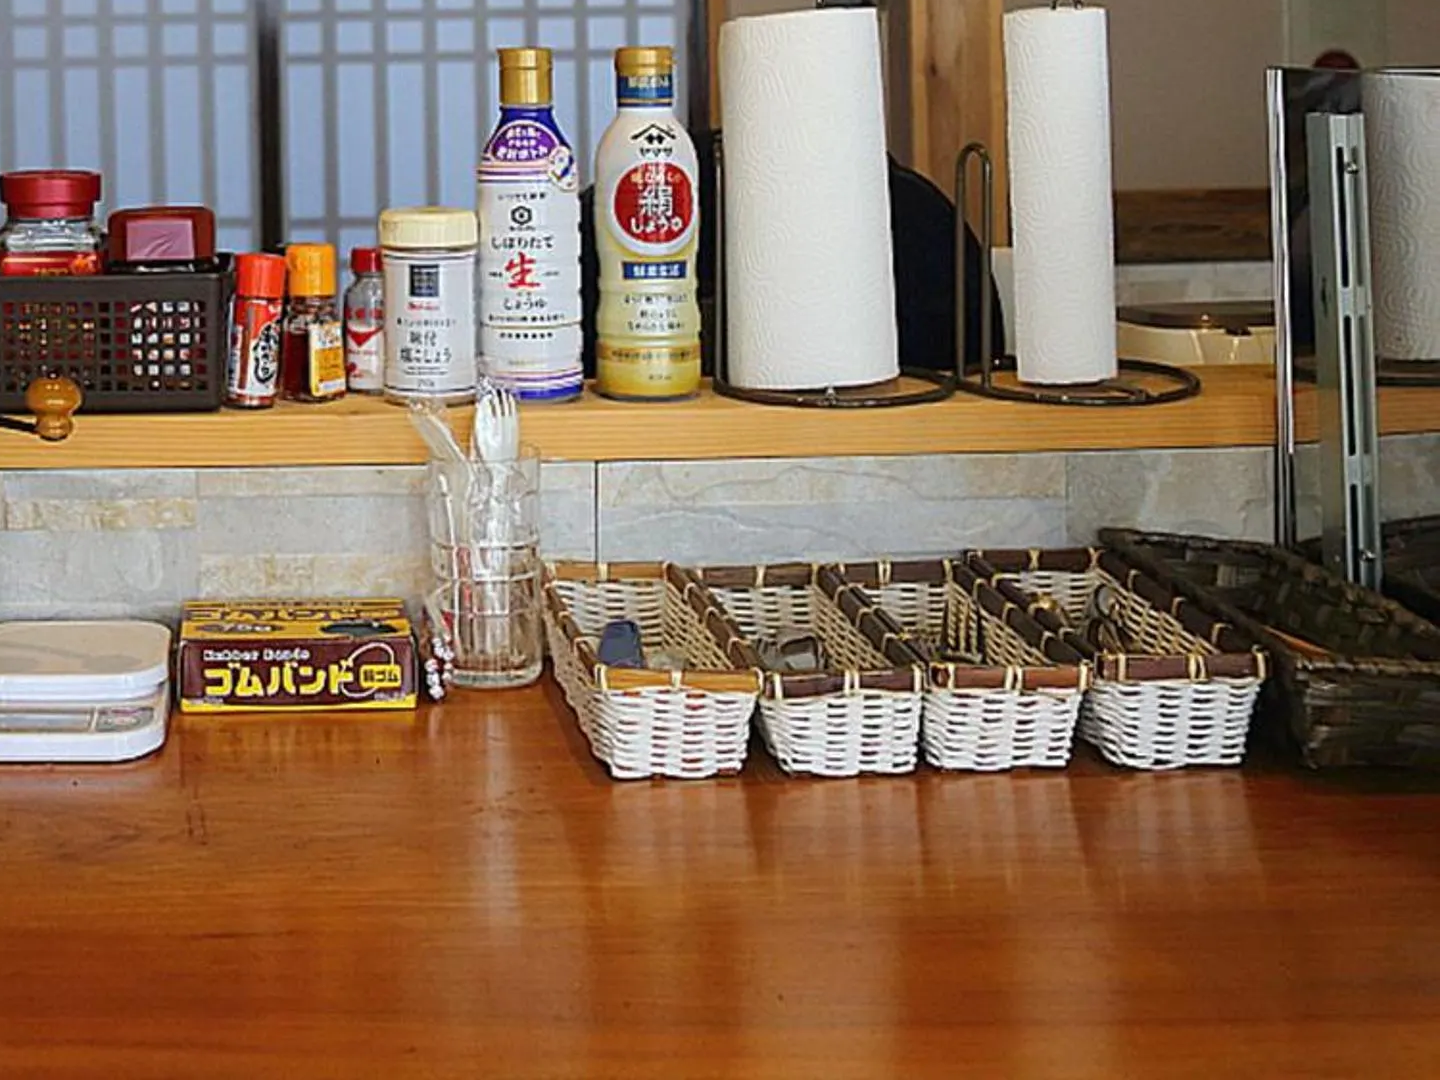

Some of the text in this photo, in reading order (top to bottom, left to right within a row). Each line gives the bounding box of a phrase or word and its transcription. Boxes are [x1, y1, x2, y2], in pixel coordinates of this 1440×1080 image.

[491, 236, 553, 249] しぼりたて
[504, 250, 541, 288] 生
[203, 659, 354, 697] ゴムバンド
